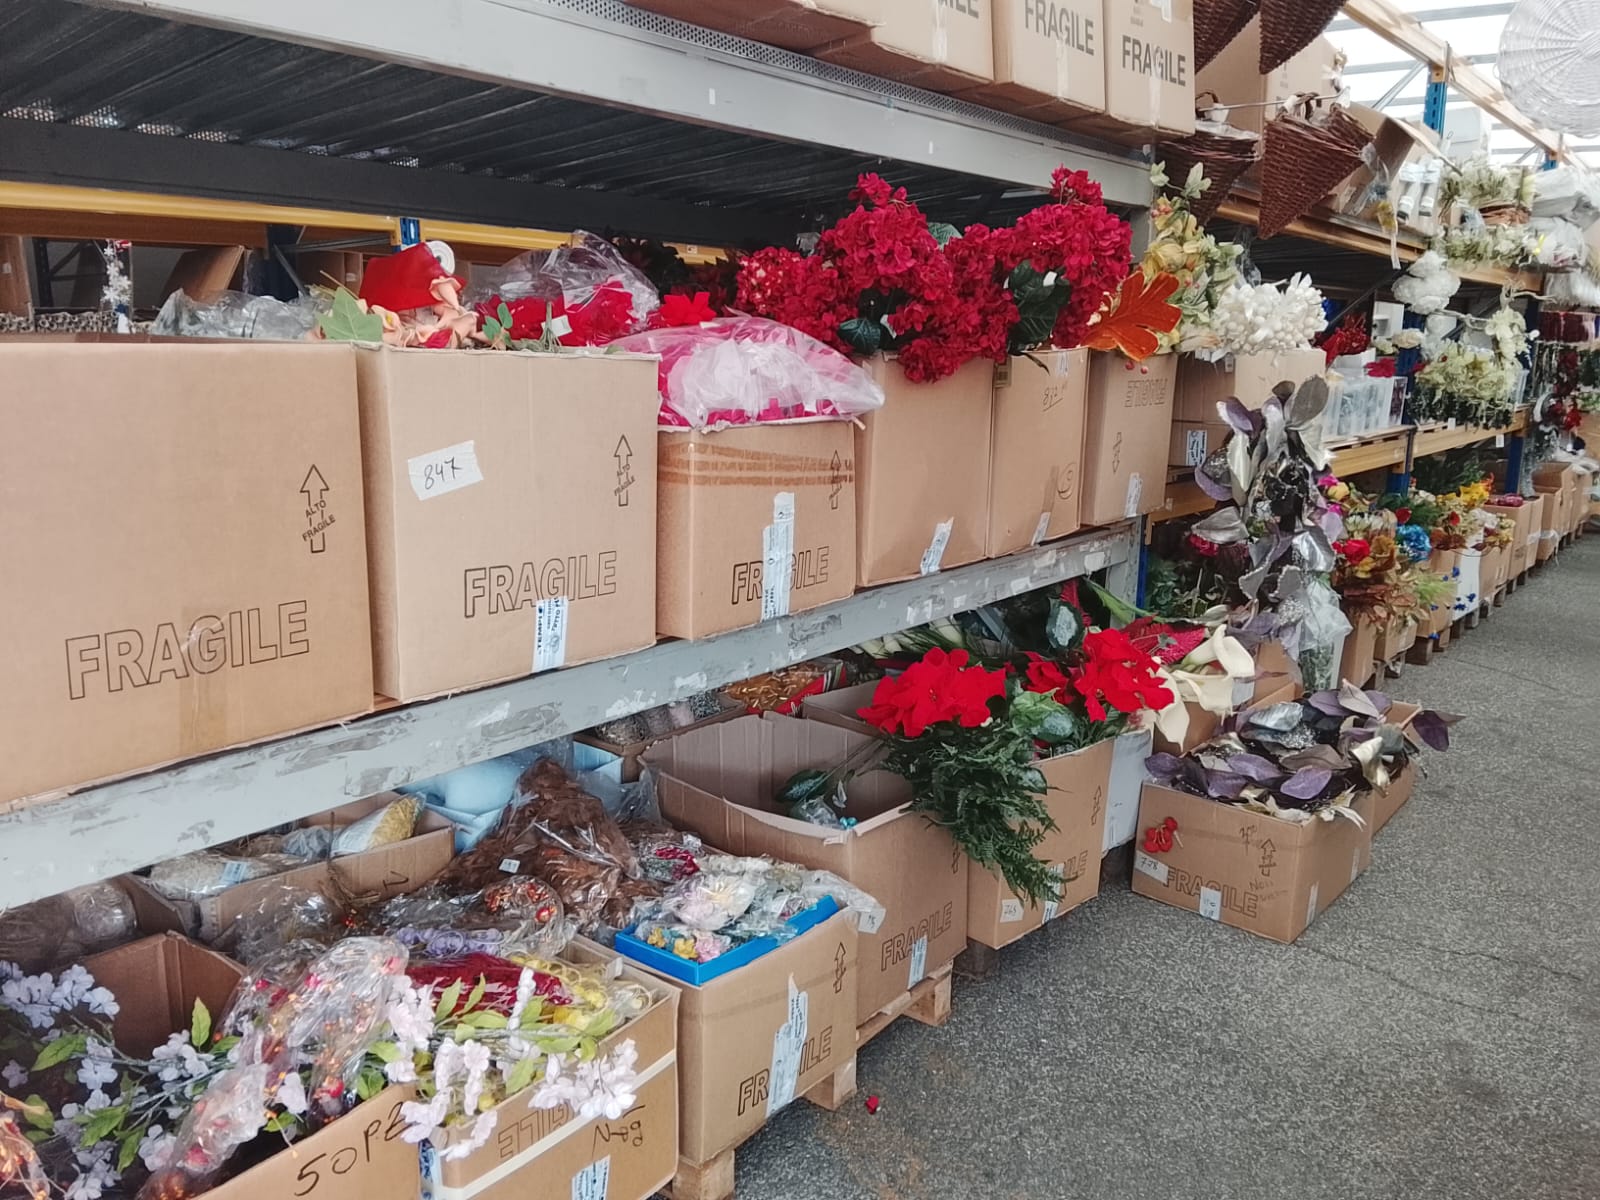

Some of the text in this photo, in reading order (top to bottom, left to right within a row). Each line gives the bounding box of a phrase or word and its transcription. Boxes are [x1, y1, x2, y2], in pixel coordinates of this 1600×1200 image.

[1024, 0, 1094, 56] FRAGILE
[1122, 34, 1186, 87] FRAGILE
[424, 456, 463, 490] 847
[302, 514, 336, 542] FRAGILE
[304, 499, 327, 518] ALTO
[464, 550, 617, 618] FRAGILE
[731, 546, 830, 605] FRILE
[65, 600, 310, 700] FRAGILE
[738, 1026, 833, 1116] FRILE
